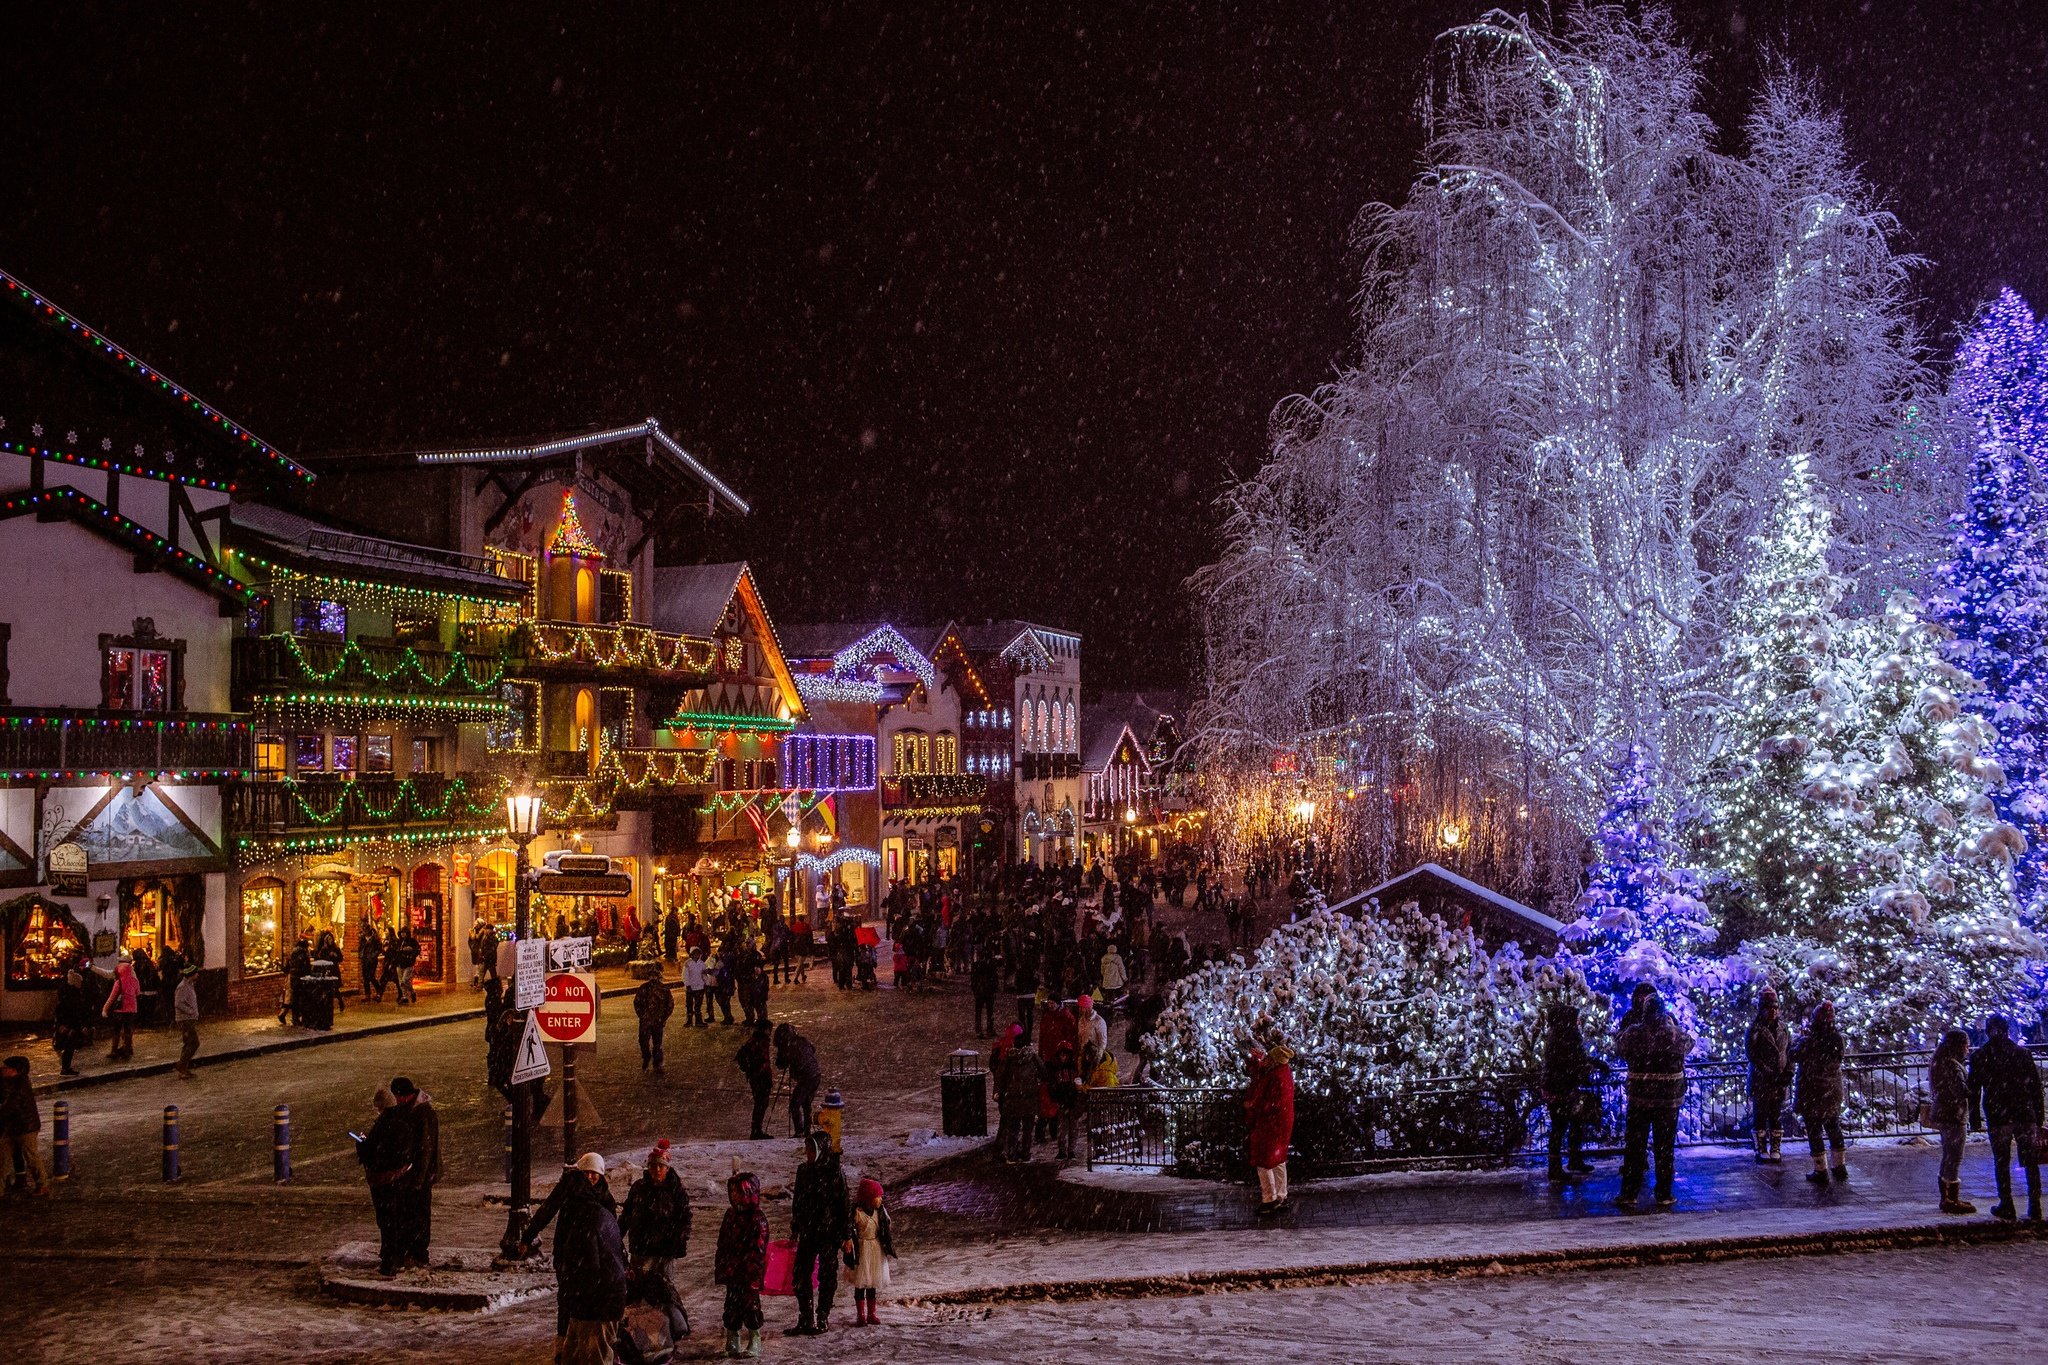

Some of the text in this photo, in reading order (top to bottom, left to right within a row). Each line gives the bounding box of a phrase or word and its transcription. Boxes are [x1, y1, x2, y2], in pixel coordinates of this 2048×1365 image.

[545, 986, 558, 997] DO
[565, 986, 585, 997] NOT
[547, 1017, 581, 1028] ENTER
